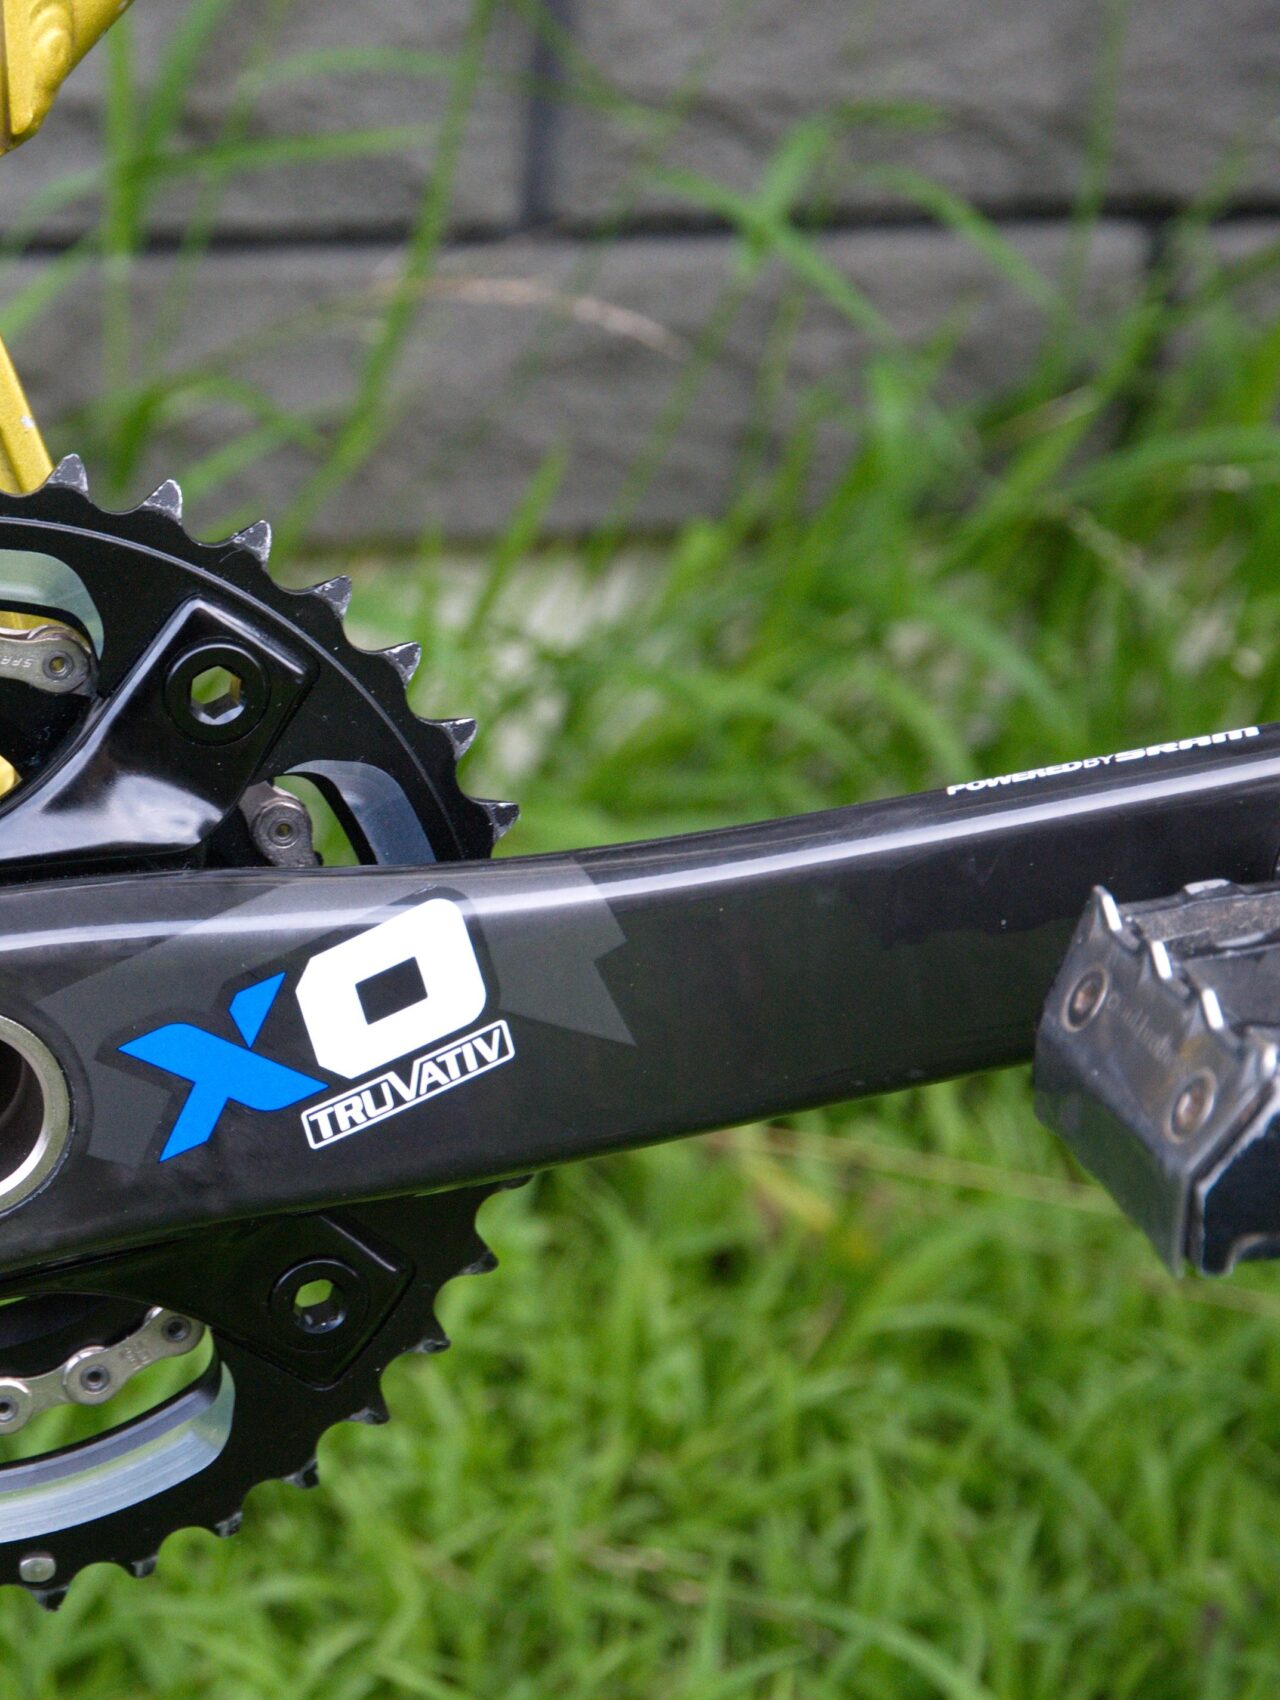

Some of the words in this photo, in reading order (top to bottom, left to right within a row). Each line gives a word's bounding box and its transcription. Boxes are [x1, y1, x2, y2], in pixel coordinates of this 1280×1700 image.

[945, 760, 1083, 796] POWERED
[1114, 726, 1260, 762] SRAM
[305, 1024, 510, 1146] TRUVATIV
